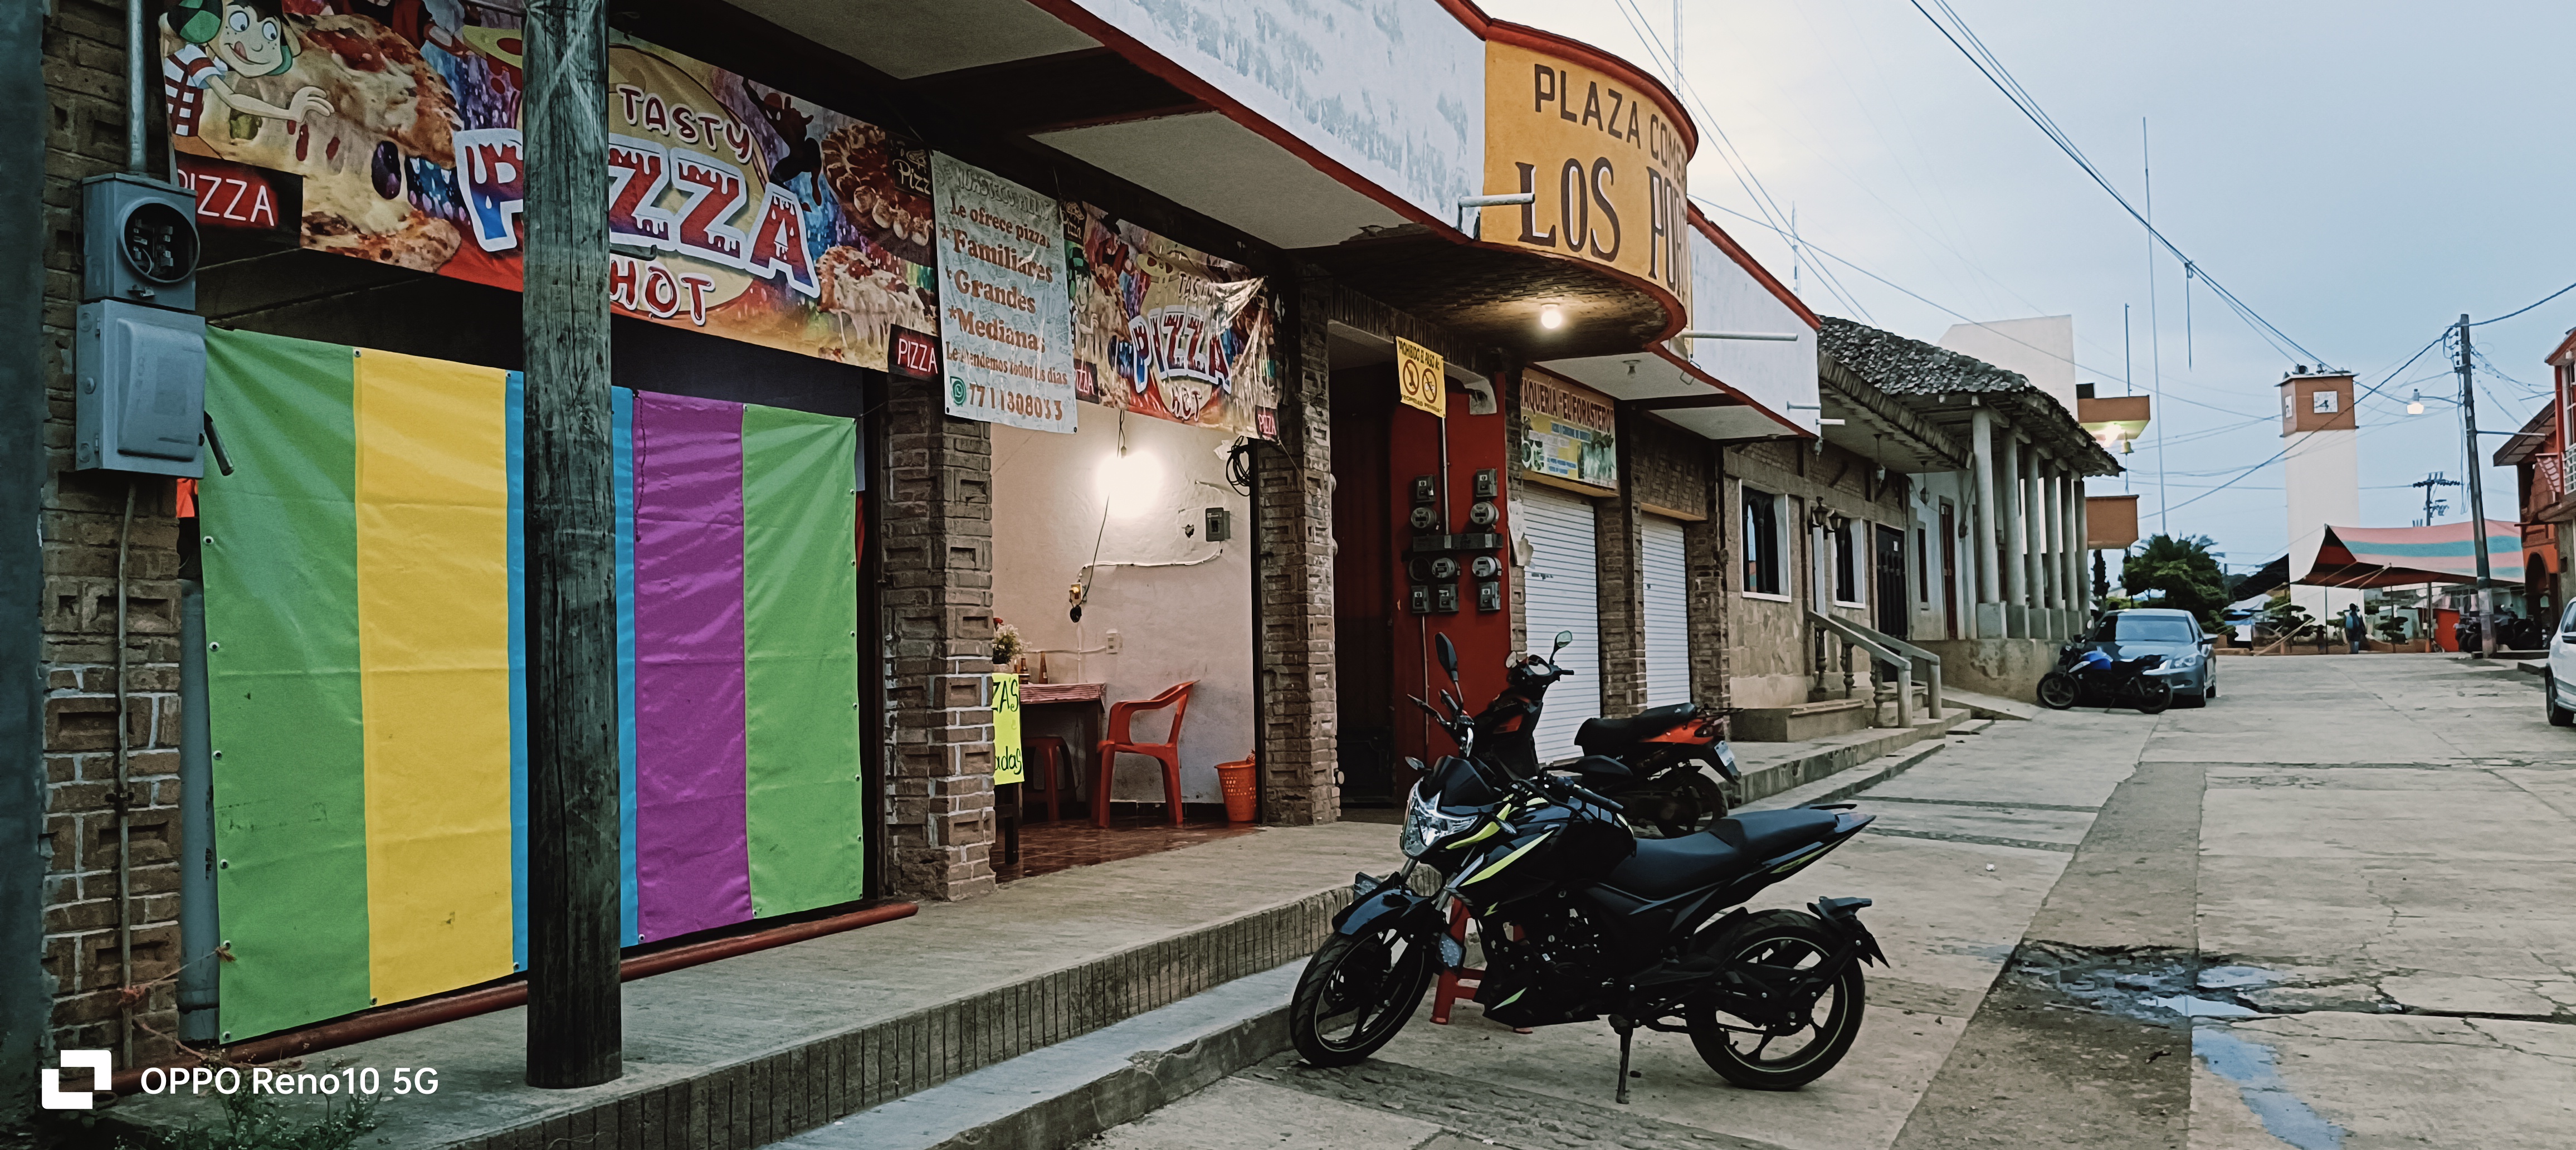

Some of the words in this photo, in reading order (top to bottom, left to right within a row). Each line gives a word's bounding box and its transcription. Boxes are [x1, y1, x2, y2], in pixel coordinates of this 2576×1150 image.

[616, 82, 753, 164] TASTY
[1534, 64, 1641, 149] PLAZA
[177, 168, 275, 227] ZZA
[454, 128, 821, 298] PZZA
[950, 196, 967, 218] Le
[970, 207, 1013, 234] ofrece
[1016, 224, 1051, 248] pizzas
[1515, 157, 1621, 262] LOS
[952, 228, 1053, 283] Familiares
[610, 257, 715, 325] HOT
[954, 269, 1036, 314] Grandes
[897, 338, 938, 374] PIZZA
[945, 341, 958, 361] Le
[1010, 360, 1033, 380] todos
[1129, 305, 1232, 394] PIZZA
[1424, 352, 1435, 369] PASO
[1075, 369, 1095, 395] IZZA
[1170, 384, 1201, 422] HOT
[1257, 413, 1277, 436] PIZZA
